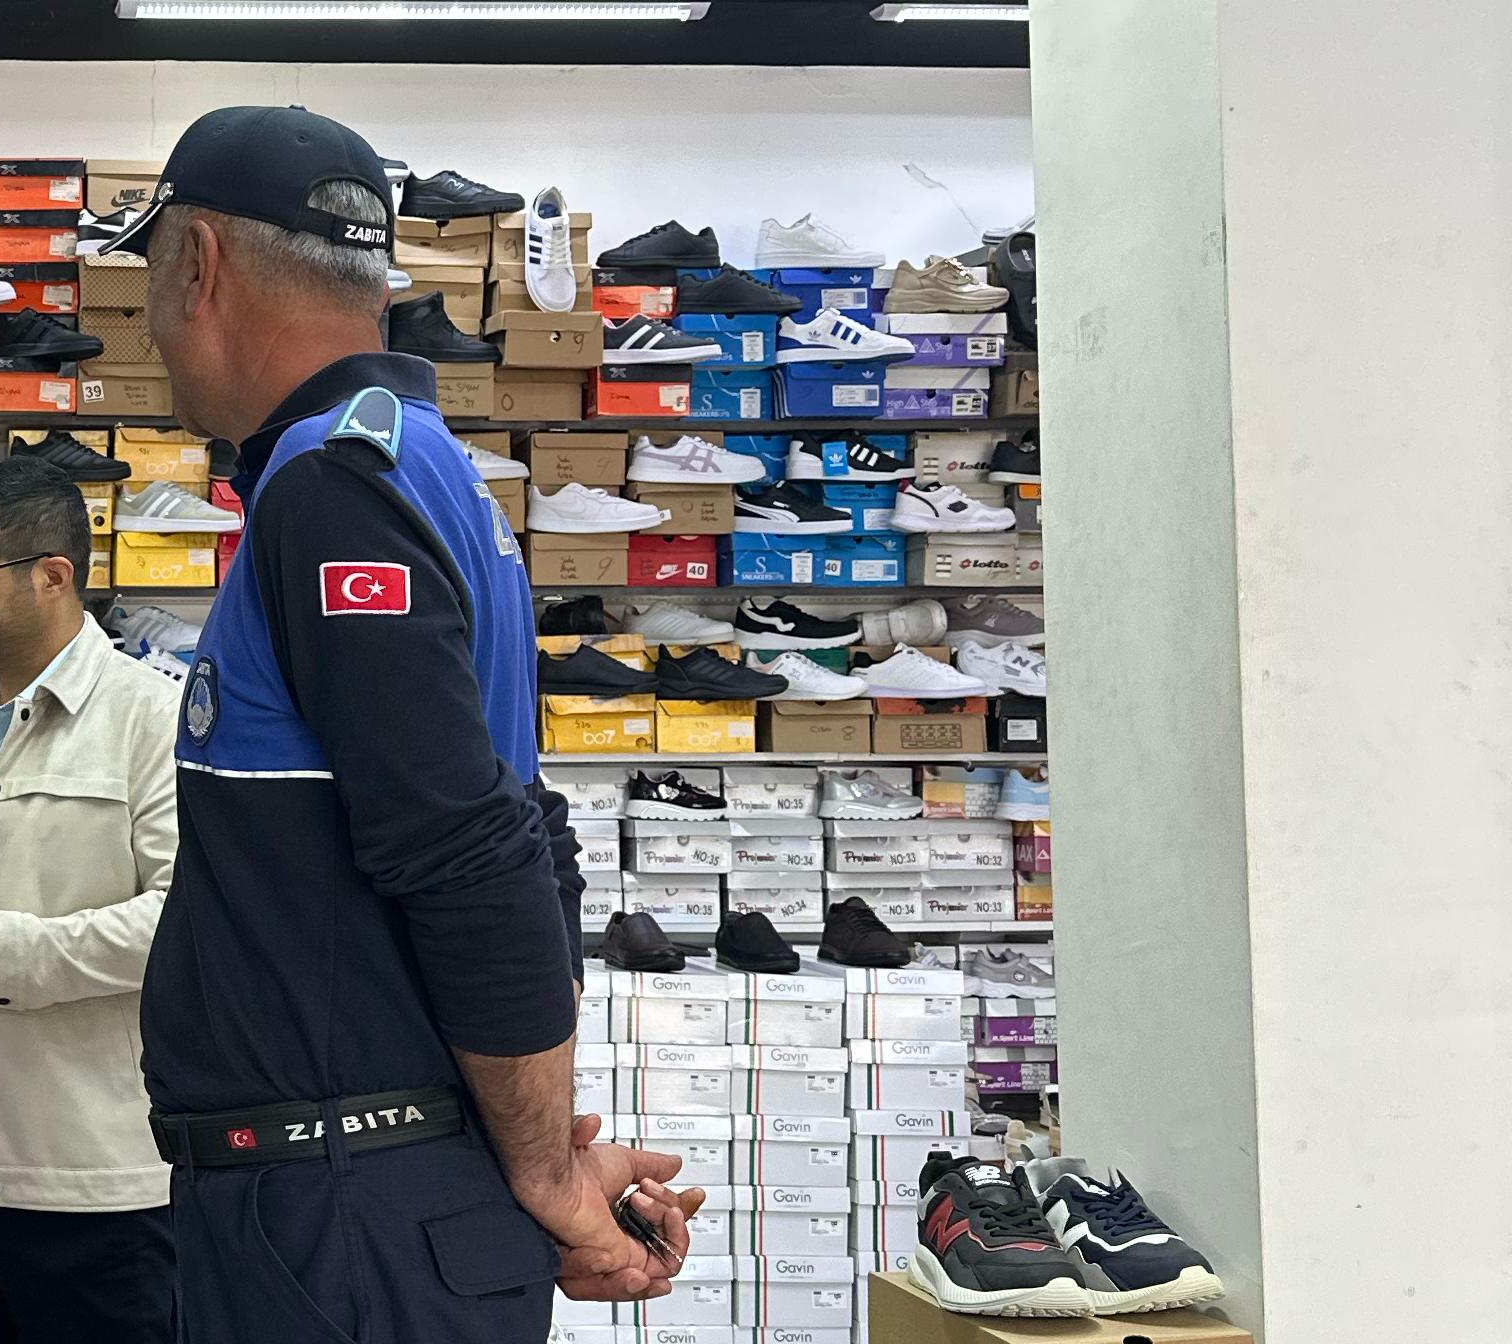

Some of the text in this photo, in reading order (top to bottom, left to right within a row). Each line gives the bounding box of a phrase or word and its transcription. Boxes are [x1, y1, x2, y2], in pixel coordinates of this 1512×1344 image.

[120, 189, 146, 201] NIKE
[344, 223, 386, 245] ZABITA
[85, 385, 101, 398] 39
[689, 565, 705, 576] 40
[825, 562, 837, 573] 40
[972, 559, 1009, 569] lotto
[592, 799, 617, 810] NO:31
[777, 799, 804, 809] NO:35
[588, 851, 614, 862] NO:31
[692, 850, 719, 866] NO:35
[787, 855, 814, 865] NO:34
[890, 855, 916, 865] NO:33
[976, 856, 1002, 865] NO:32
[583, 905, 609, 915] NO:32
[687, 905, 712, 915] NO:35
[781, 900, 807, 917] NO:34
[889, 905, 914, 914] NO:34
[976, 903, 1002, 912] NO:33
[653, 977, 691, 991] Gavin
[887, 972, 926, 985] Gavin
[766, 979, 804, 993] Gavin
[657, 1048, 695, 1062] Gavin
[892, 1042, 931, 1055] Gavin
[771, 1048, 809, 1063] Gavin
[657, 1117, 695, 1131] Gavin
[773, 1119, 811, 1133] Gavin
[895, 1114, 933, 1128] Gavin
[773, 1189, 812, 1204] Gavin
[776, 1260, 815, 1275] Gavin
[774, 1329, 813, 1344] Gavin
